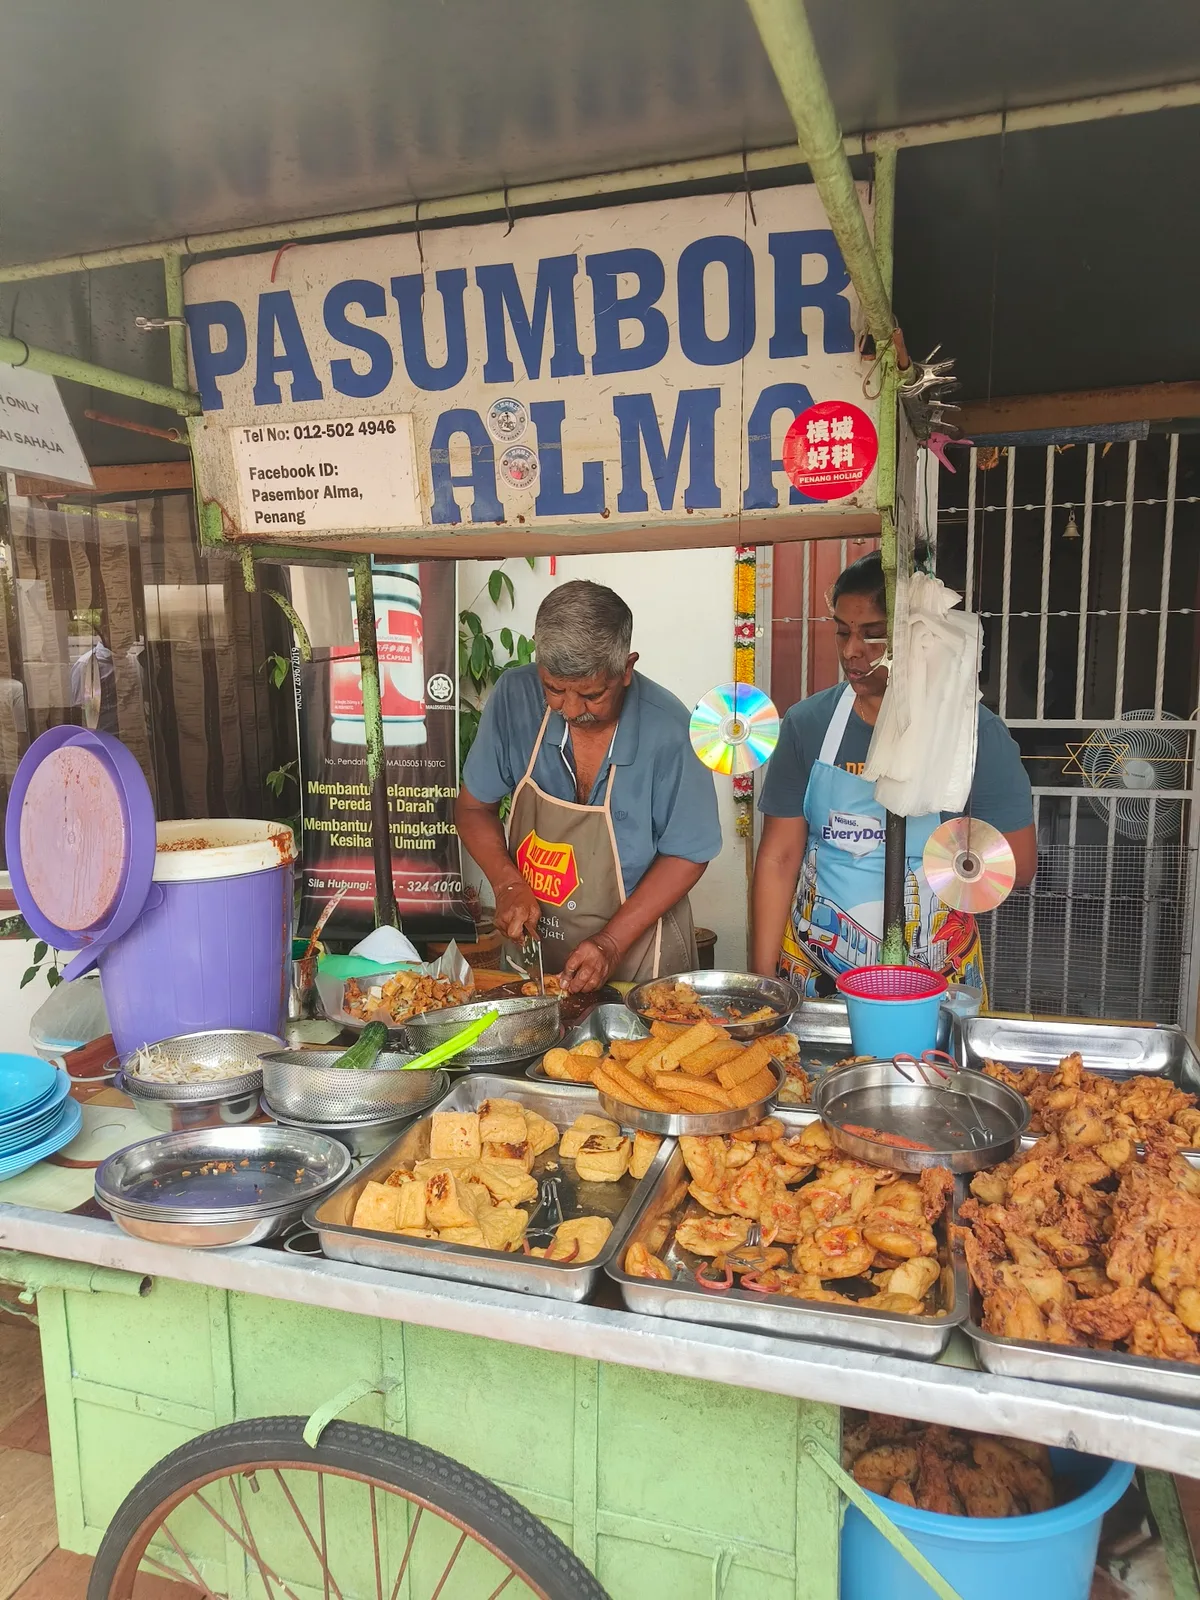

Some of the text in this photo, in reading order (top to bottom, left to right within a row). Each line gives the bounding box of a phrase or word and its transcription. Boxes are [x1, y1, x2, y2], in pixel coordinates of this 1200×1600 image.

[186, 228, 856, 411] PASUMBOR
[6, 395, 40, 415] ONLY
[243, 419, 396, 443] Tel No: 012-502 4946
[14, 432, 65, 454] SAHAJA
[430, 382, 828, 525] ALMA
[807, 443, 854, 470] 好料
[249, 462, 339, 480] Facebook ID:
[799, 471, 863, 484] PENANG HOLIAO
[252, 485, 363, 503] Pasembor Alma,
[254, 510, 306, 526] Penang
[337, 758, 368, 766] Pendaft
[386, 759, 446, 768] MAL05051150TC
[307, 780, 457, 798] Membantu elancarkan
[329, 797, 435, 813] Peredan Darah
[330, 833, 436, 850] Kesiha Umum
[308, 878, 325, 889] Sila
[327, 880, 372, 891] Hubungi:
[407, 881, 430, 893] 324
[432, 881, 462, 893] 1010
[539, 915, 560, 928] asli
